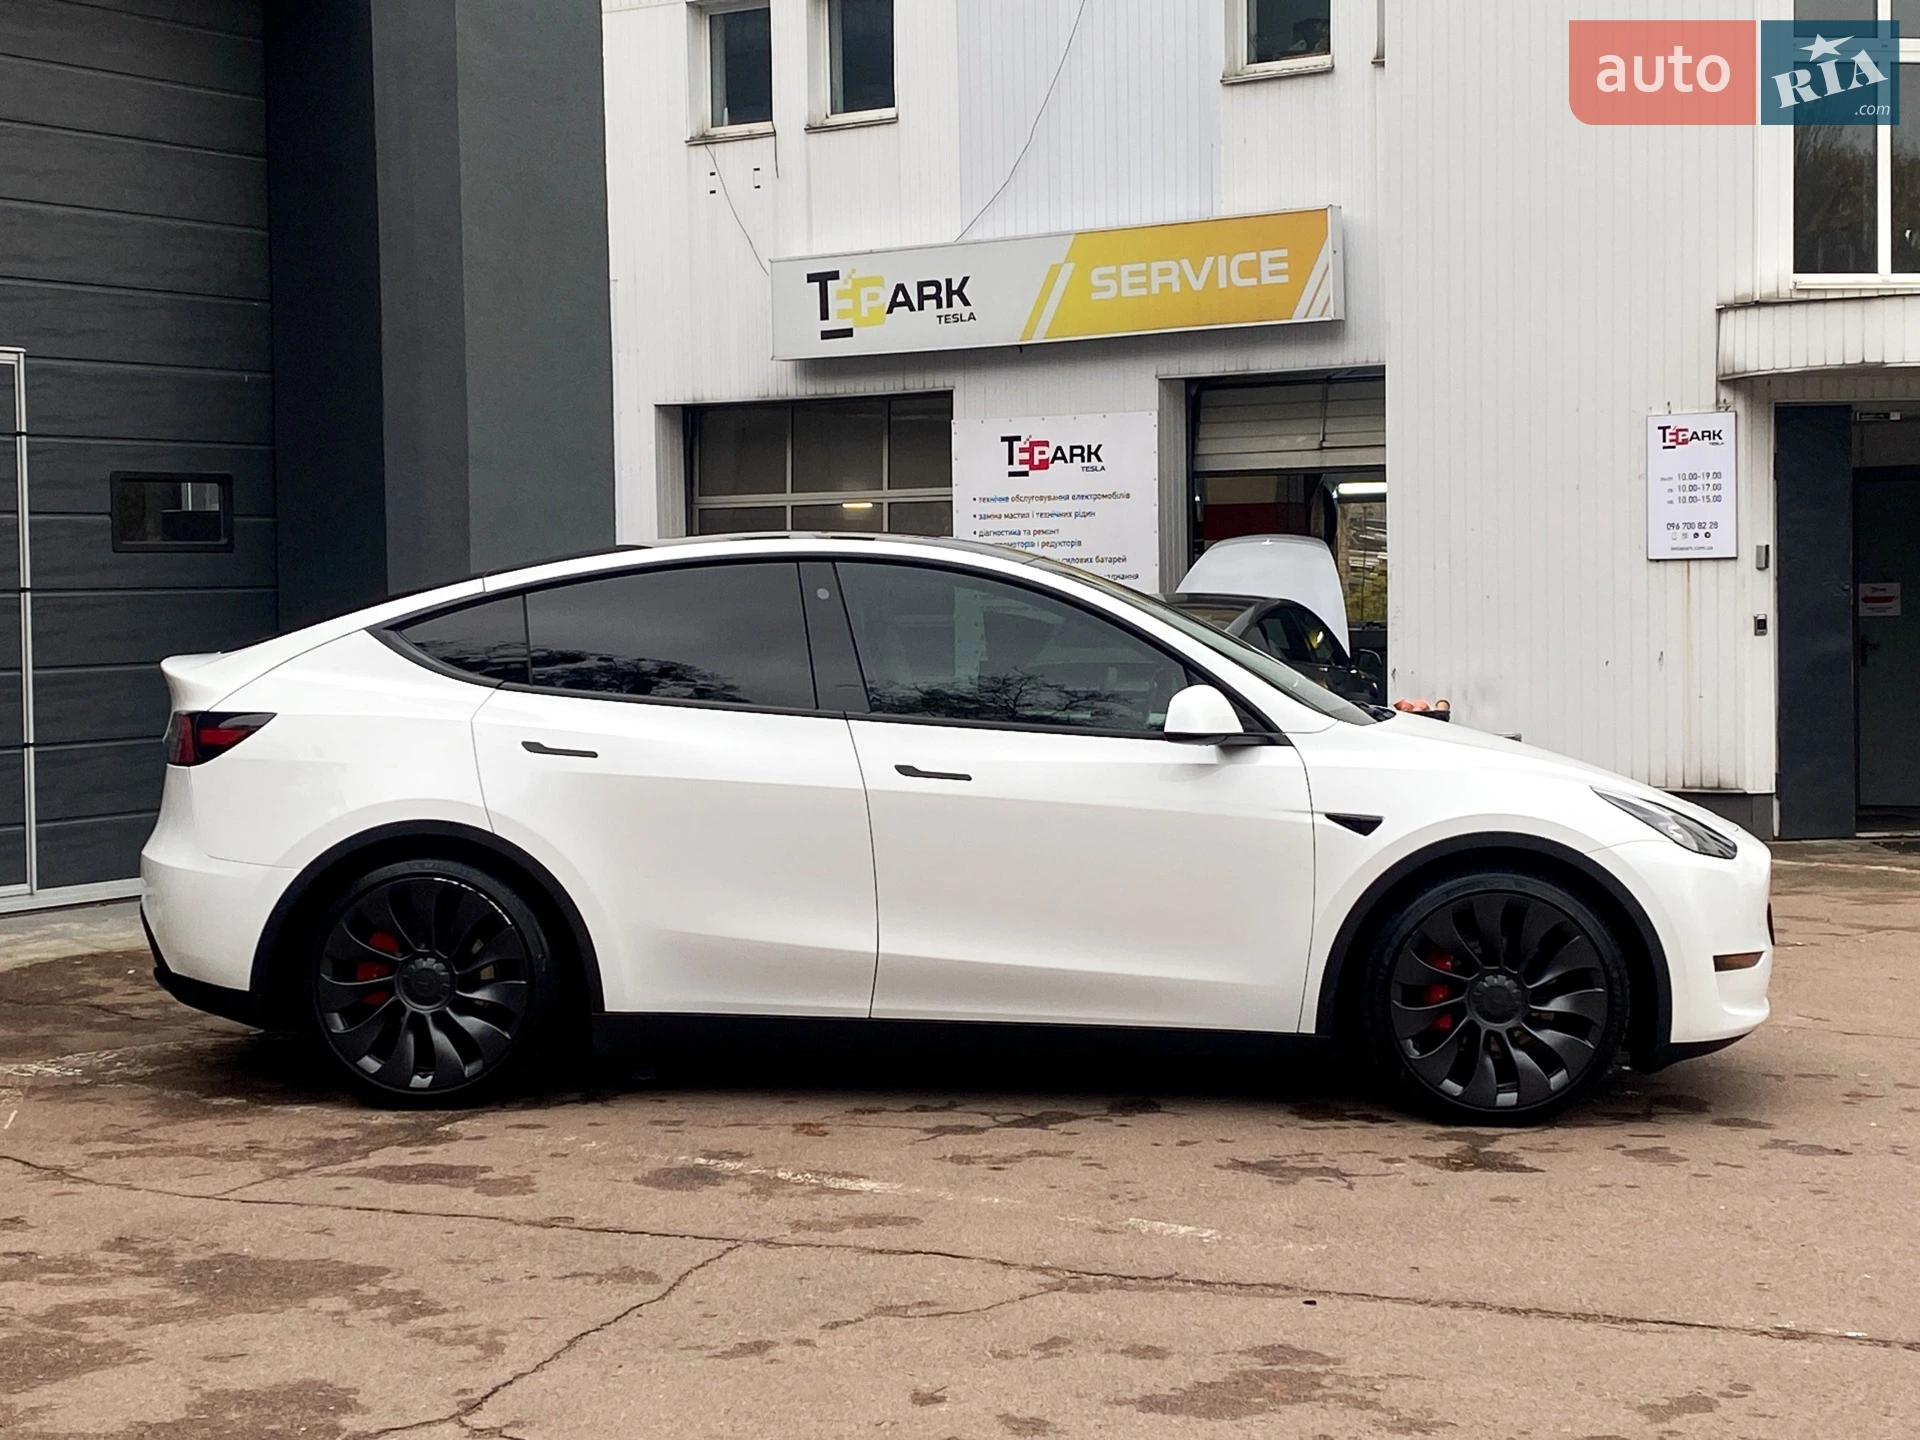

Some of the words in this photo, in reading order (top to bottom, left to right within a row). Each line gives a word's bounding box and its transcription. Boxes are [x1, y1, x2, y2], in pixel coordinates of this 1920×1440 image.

[1090, 249, 1289, 300] SERVICE
[936, 312, 977, 325] TESLA
[1081, 465, 1106, 473] TESLA
[1678, 471, 1722, 481] 10.00-19.00
[1678, 482, 1722, 493] 10.00-17.00
[978, 494, 1010, 504] технічне
[1011, 493, 1070, 505] обслуговування
[1071, 491, 1131, 503] електромобілів
[1678, 494, 1722, 504] 10.00-15.00
[978, 512, 1002, 520] заміна
[1074, 508, 1096, 519] рідин
[1666, 522, 1681, 531] 096
[1682, 522, 1696, 530] 700
[1697, 521, 1707, 530] 82
[1708, 521, 1719, 530] 28
[978, 528, 1021, 538] діагностика
[1023, 528, 1031, 536] та
[1032, 528, 1060, 537] ремонт
[1041, 538, 1082, 549] редукторів
[1095, 554, 1127, 565] батарей
